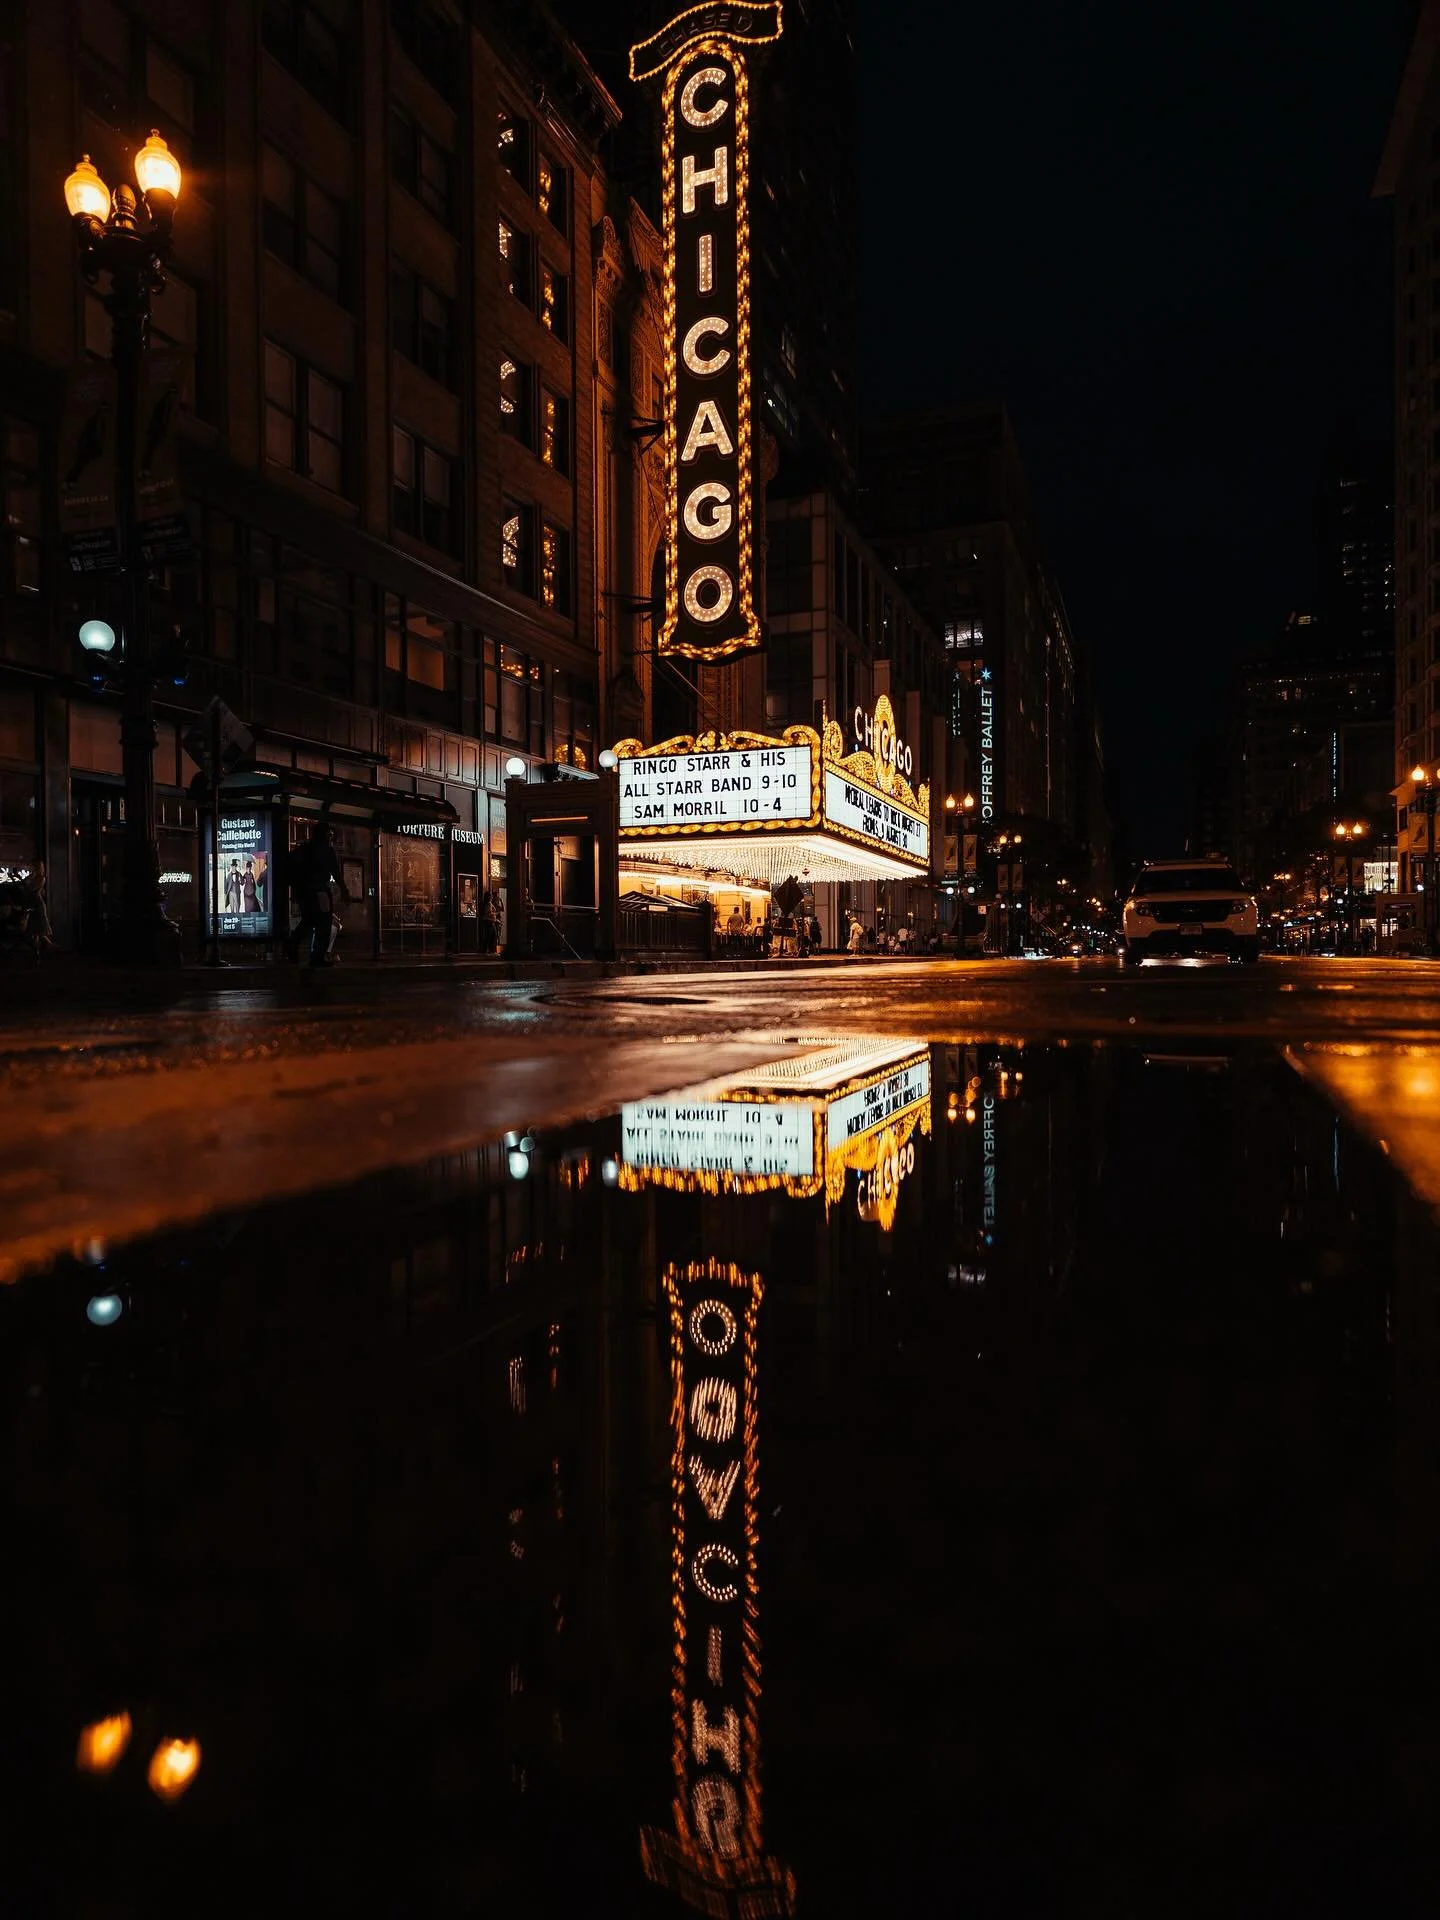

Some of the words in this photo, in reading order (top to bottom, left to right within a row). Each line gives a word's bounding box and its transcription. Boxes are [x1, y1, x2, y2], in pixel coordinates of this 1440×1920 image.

[681, 67, 733, 622] CHICAGO
[981, 687, 993, 749] BALLET
[855, 706, 912, 776] CHICAGO
[633, 759, 677, 775] RINGO
[687, 755, 730, 771] STARR
[741, 753, 751, 768] &
[760, 751, 786, 767] HIS
[624, 783, 649, 798] ALL
[657, 780, 703, 796] STARR
[711, 776, 751, 793] BAND
[634, 804, 664, 819] SAM
[673, 800, 727, 817] MORRIL
[217, 829, 262, 841] Caillebotte
[221, 818, 256, 829] Gustave
